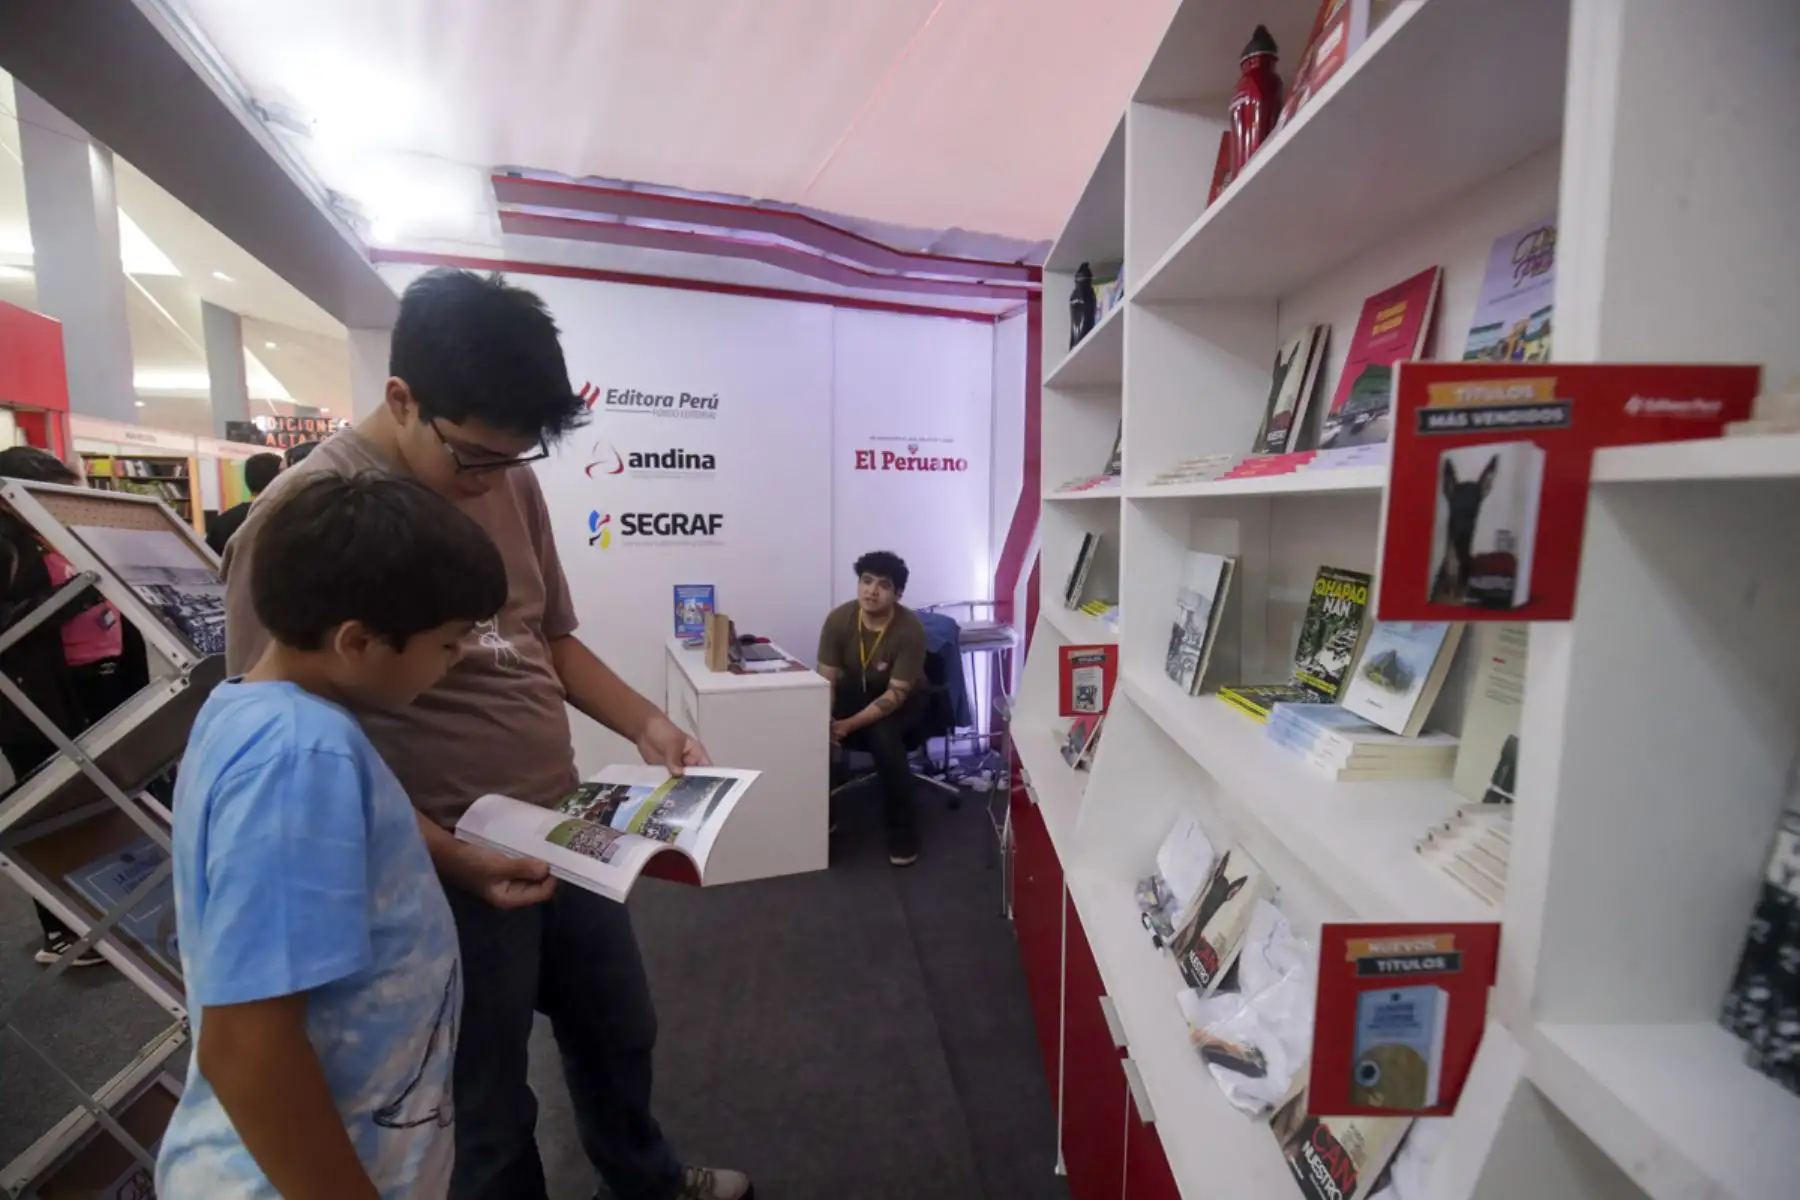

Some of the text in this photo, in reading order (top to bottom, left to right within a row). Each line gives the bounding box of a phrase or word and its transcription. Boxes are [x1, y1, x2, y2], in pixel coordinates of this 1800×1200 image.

[605, 388, 719, 410] Editora Perú
[628, 449, 716, 470] andina
[855, 449, 968, 471] El Peruano
[620, 512, 723, 536] SEGRAF
[1311, 1123, 1359, 1195] CAN
